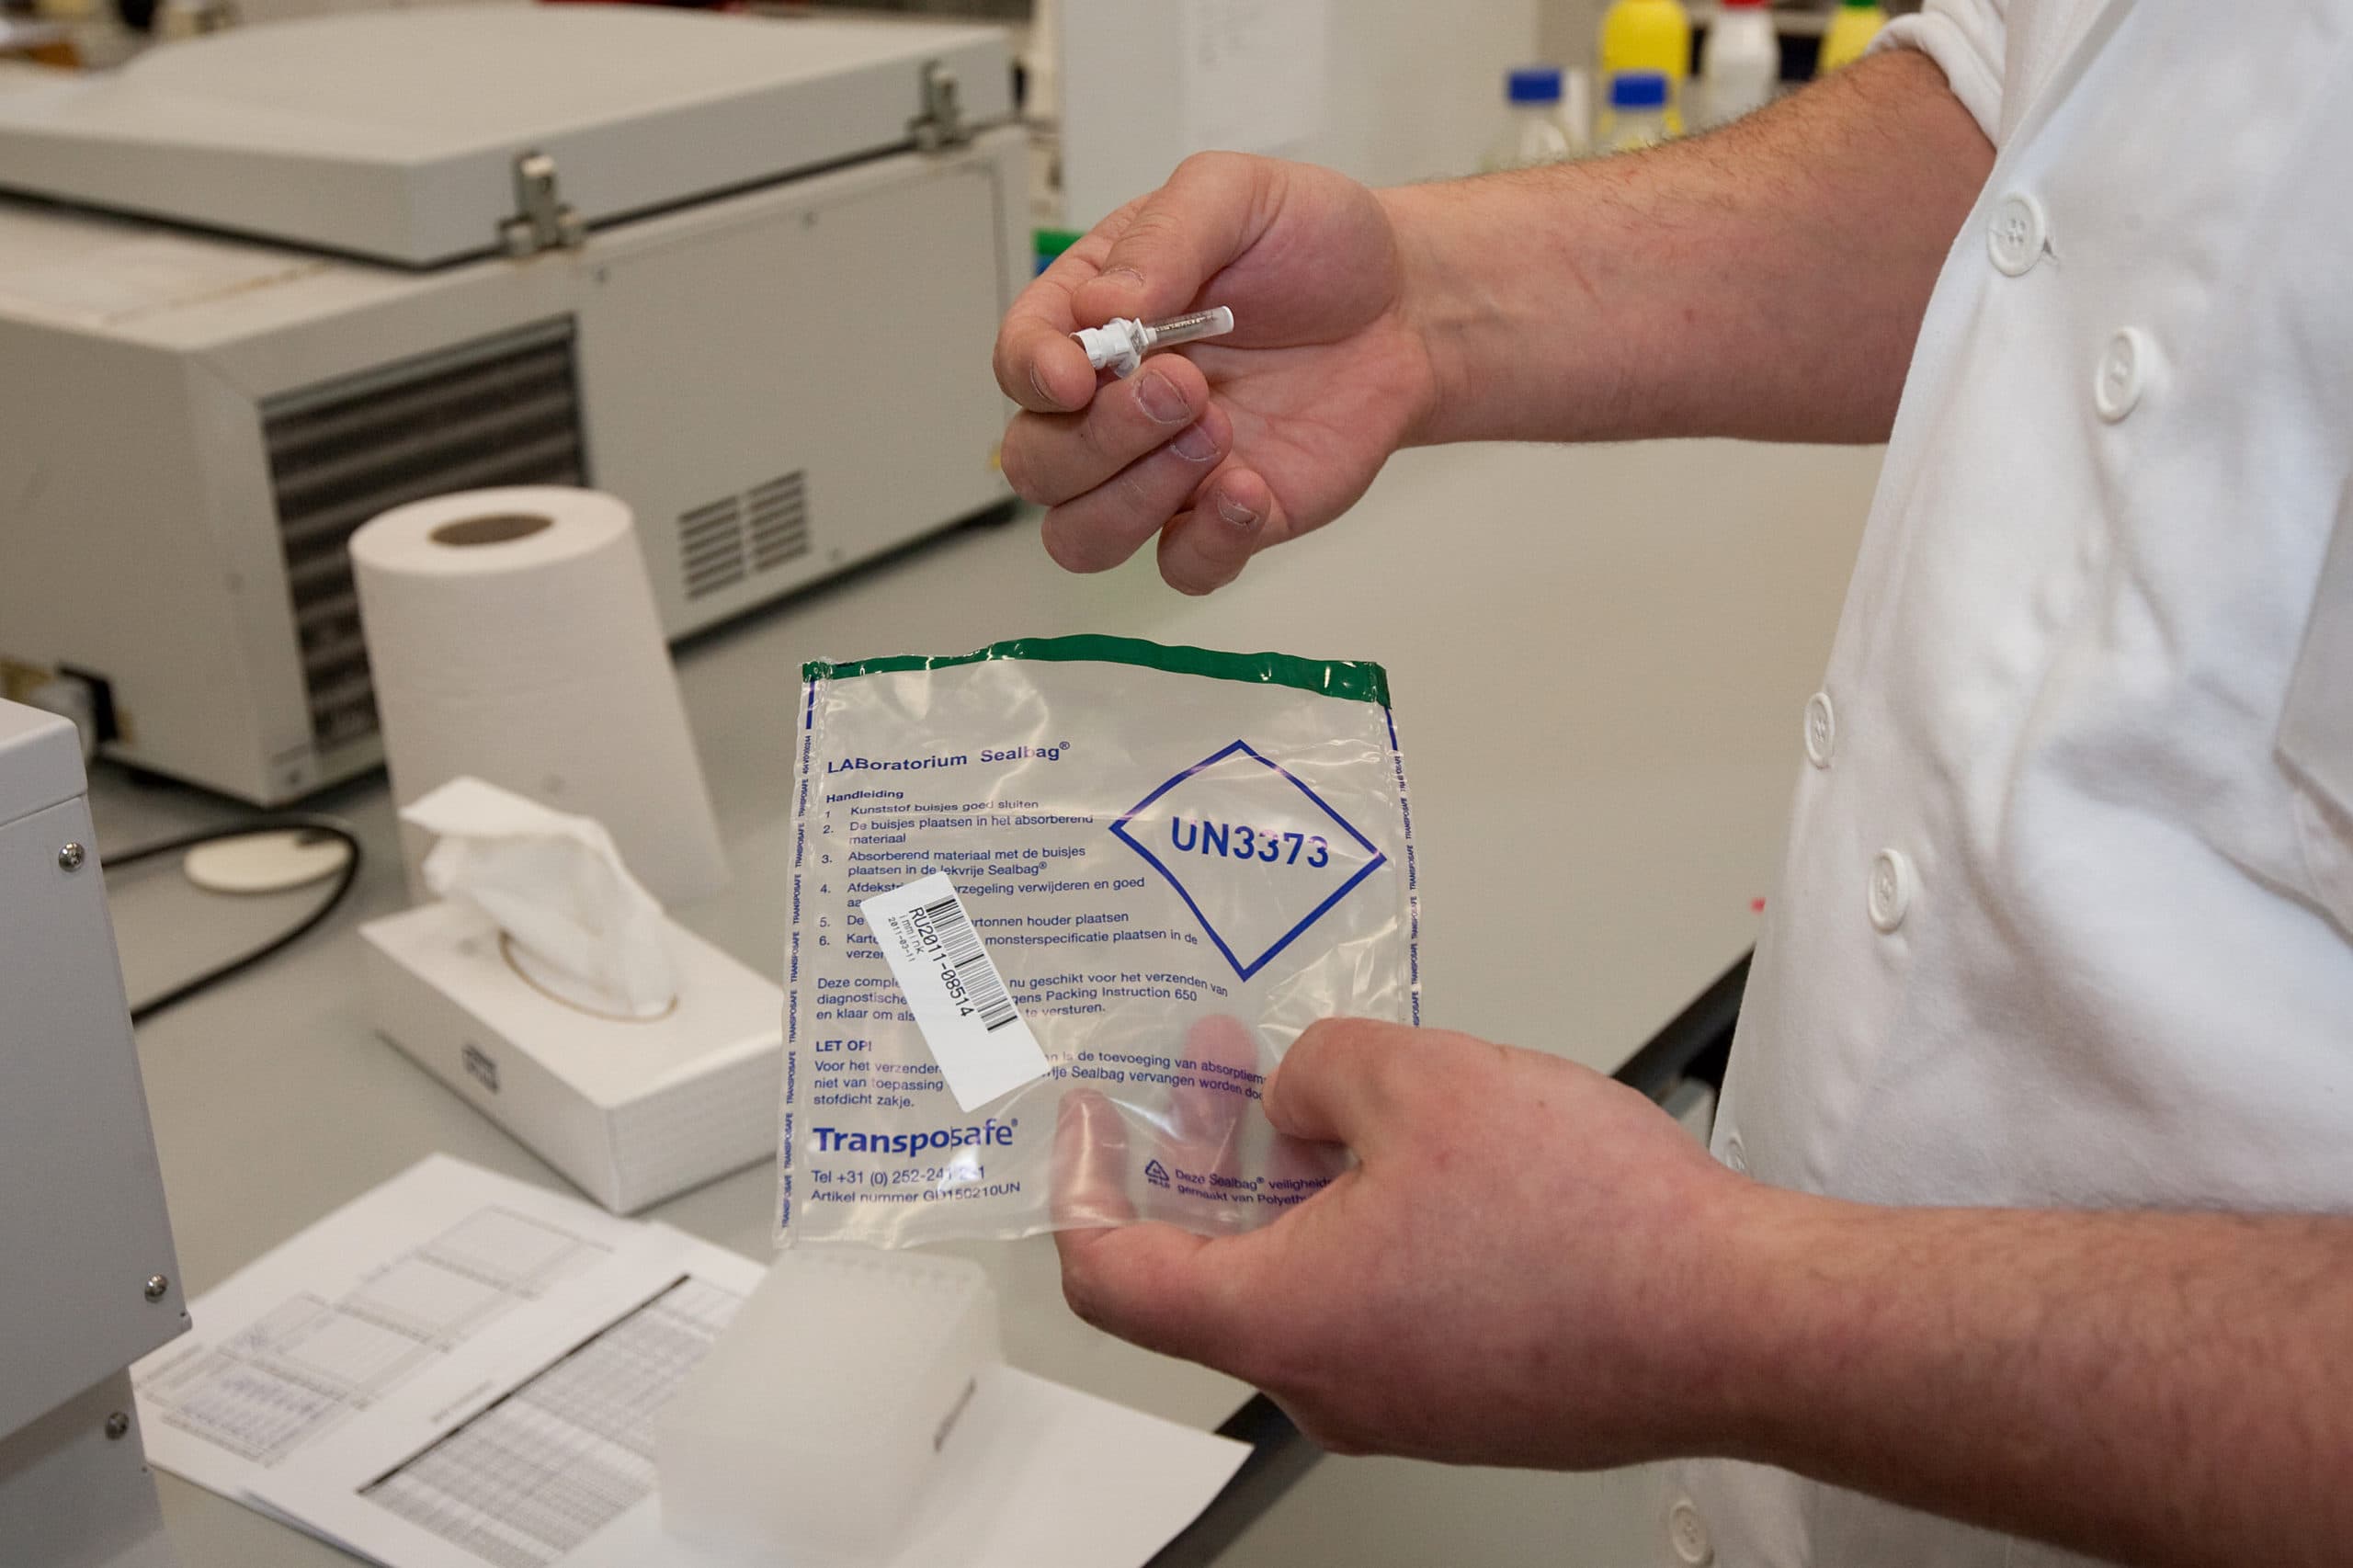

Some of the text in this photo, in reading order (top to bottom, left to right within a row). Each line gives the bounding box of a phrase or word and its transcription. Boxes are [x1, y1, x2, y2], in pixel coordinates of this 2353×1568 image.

[827, 754, 967, 773] LABoratorium
[826, 790, 904, 803] Handleiding
[850, 804, 911, 816] Kunststof
[914, 803, 958, 812] buisjes
[962, 801, 995, 812] goed
[998, 800, 1039, 809] sluiten
[824, 824, 835, 835] 2.
[849, 822, 868, 831] De
[871, 820, 915, 831] buisjes
[919, 818, 972, 829] plaatsen
[976, 815, 987, 825] in
[1401, 798, 1412, 840] TRANSPOSAFE
[849, 833, 906, 845] materiaal
[1172, 816, 1329, 868] UN3373
[822, 846, 1086, 864] 3. Absorberend materiaal met de buisjes
[848, 866, 901, 878] plaatsen
[905, 866, 917, 875] in
[921, 866, 936, 875] de
[1406, 845, 1417, 890] TRANSPOSAFE
[820, 883, 831, 893] 4.
[1018, 880, 1090, 894] verwijderen
[1094, 881, 1109, 890] en
[1113, 877, 1145, 892] goed
[793, 873, 801, 925] TRANSPOSAFE
[820, 916, 831, 927] 5.
[847, 915, 864, 926] De
[1027, 915, 1071, 926] houder
[1075, 912, 1129, 929] plaatsen
[819, 936, 830, 947] 6.
[985, 931, 1108, 947] monsterspecificatie
[1112, 929, 1167, 944] plaatsen
[1170, 928, 1180, 939] in
[1184, 932, 1199, 945] de
[790, 932, 800, 983] TRANSPOSAFE
[908, 906, 974, 1017] RU2011-08514
[818, 978, 850, 989] Deze
[1009, 978, 1026, 988] nu
[1029, 973, 1083, 991] geschikt
[1088, 972, 1117, 983] voor
[1121, 972, 1142, 983] het
[1145, 972, 1208, 991] verzenden
[1210, 982, 1229, 998] van
[816, 992, 908, 1006] diagnostische
[1046, 988, 1097, 1001] Packing
[1103, 988, 1171, 999] Instruction
[1175, 988, 1198, 1002] 650
[789, 989, 798, 1044] TRANSPOSAFE
[816, 1003, 1106, 1022] en klaar om als te versturen.
[816, 1040, 842, 1051] LET
[814, 1060, 846, 1072] Voor
[849, 1060, 870, 1072] het
[1077, 1051, 1094, 1062] de
[1098, 1051, 1171, 1069] toevoeging
[1175, 1058, 1197, 1070] van
[787, 1051, 796, 1105] TRANSPOSAFE
[814, 1078, 838, 1088] niet
[843, 1078, 867, 1088] van
[1072, 1066, 1125, 1083] Sealbag
[1129, 1073, 1195, 1087] vervangen
[1199, 1077, 1242, 1096] worden
[813, 1094, 915, 1108] stofdicht zakje.
[784, 1113, 792, 1169] TRANSPOSAFE
[812, 1170, 832, 1184] Tel
[836, 1171, 864, 1184] +31
[870, 1171, 889, 1187] (0)
[1176, 1169, 1206, 1185] Deze
[811, 1190, 855, 1202] Artikel
[860, 1193, 919, 1202] nummer
[1177, 1185, 1227, 1202] gemaakt
[1232, 1193, 1254, 1203] van
